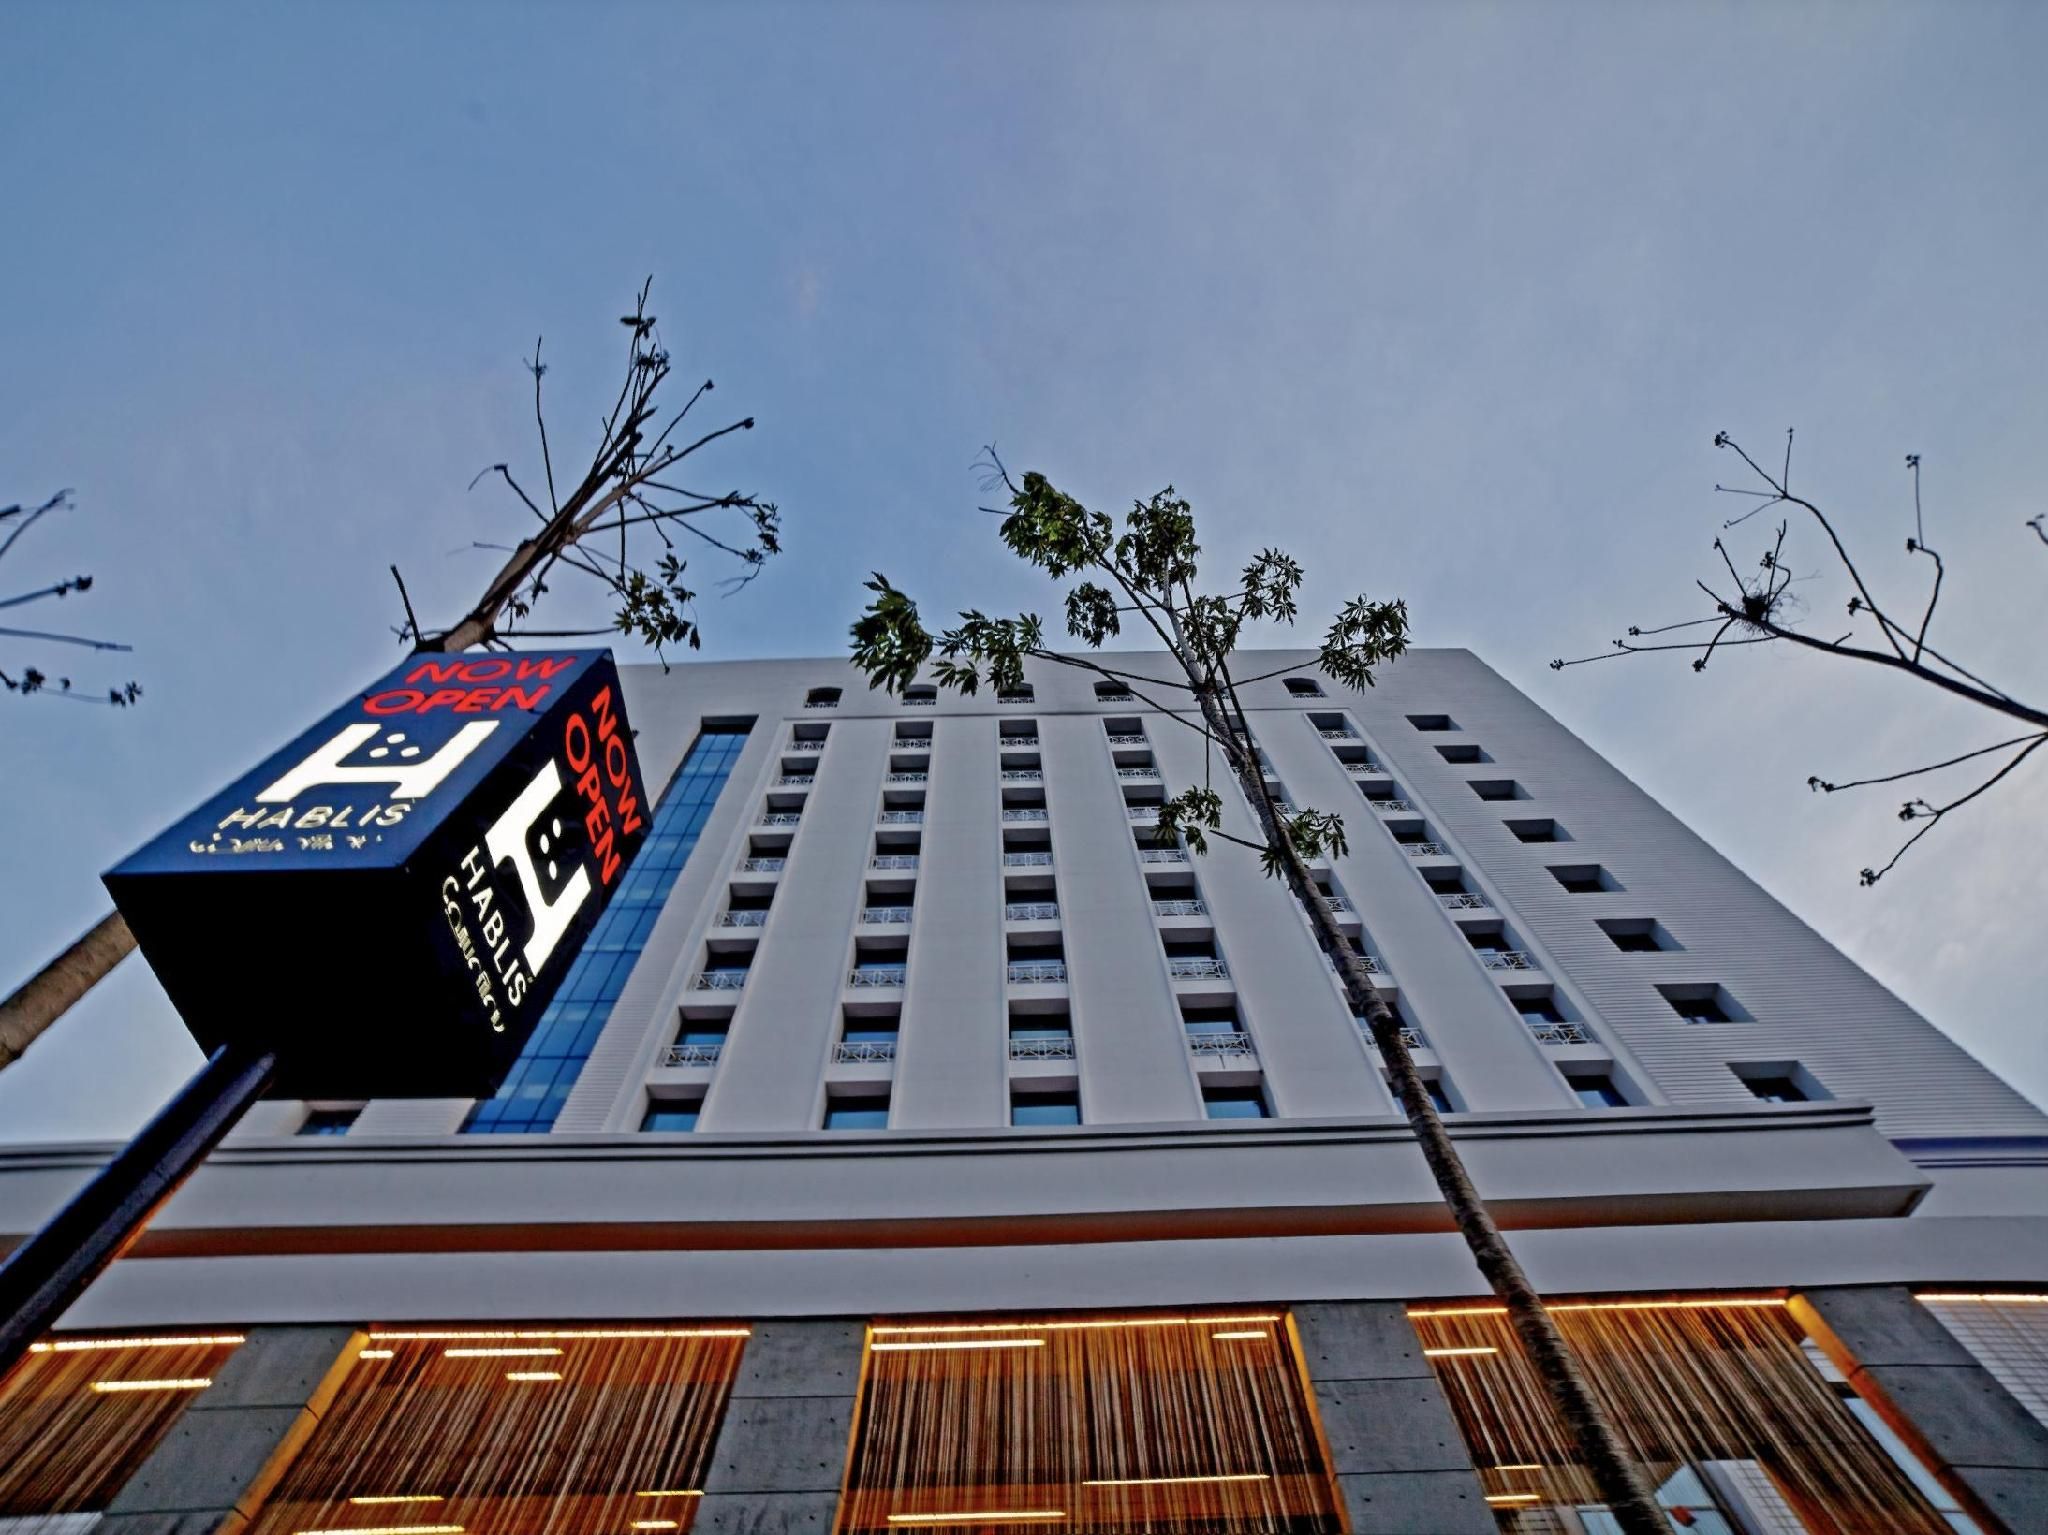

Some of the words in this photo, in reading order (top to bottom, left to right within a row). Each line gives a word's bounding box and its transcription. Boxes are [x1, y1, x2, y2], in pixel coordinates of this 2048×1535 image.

[362, 686, 550, 715] OPEN
[405, 656, 576, 684] NOW
[565, 712, 622, 885] OPEN
[591, 685, 642, 835] NOW
[217, 804, 411, 829] HABLIS
[461, 845, 527, 1007] HABLIS
